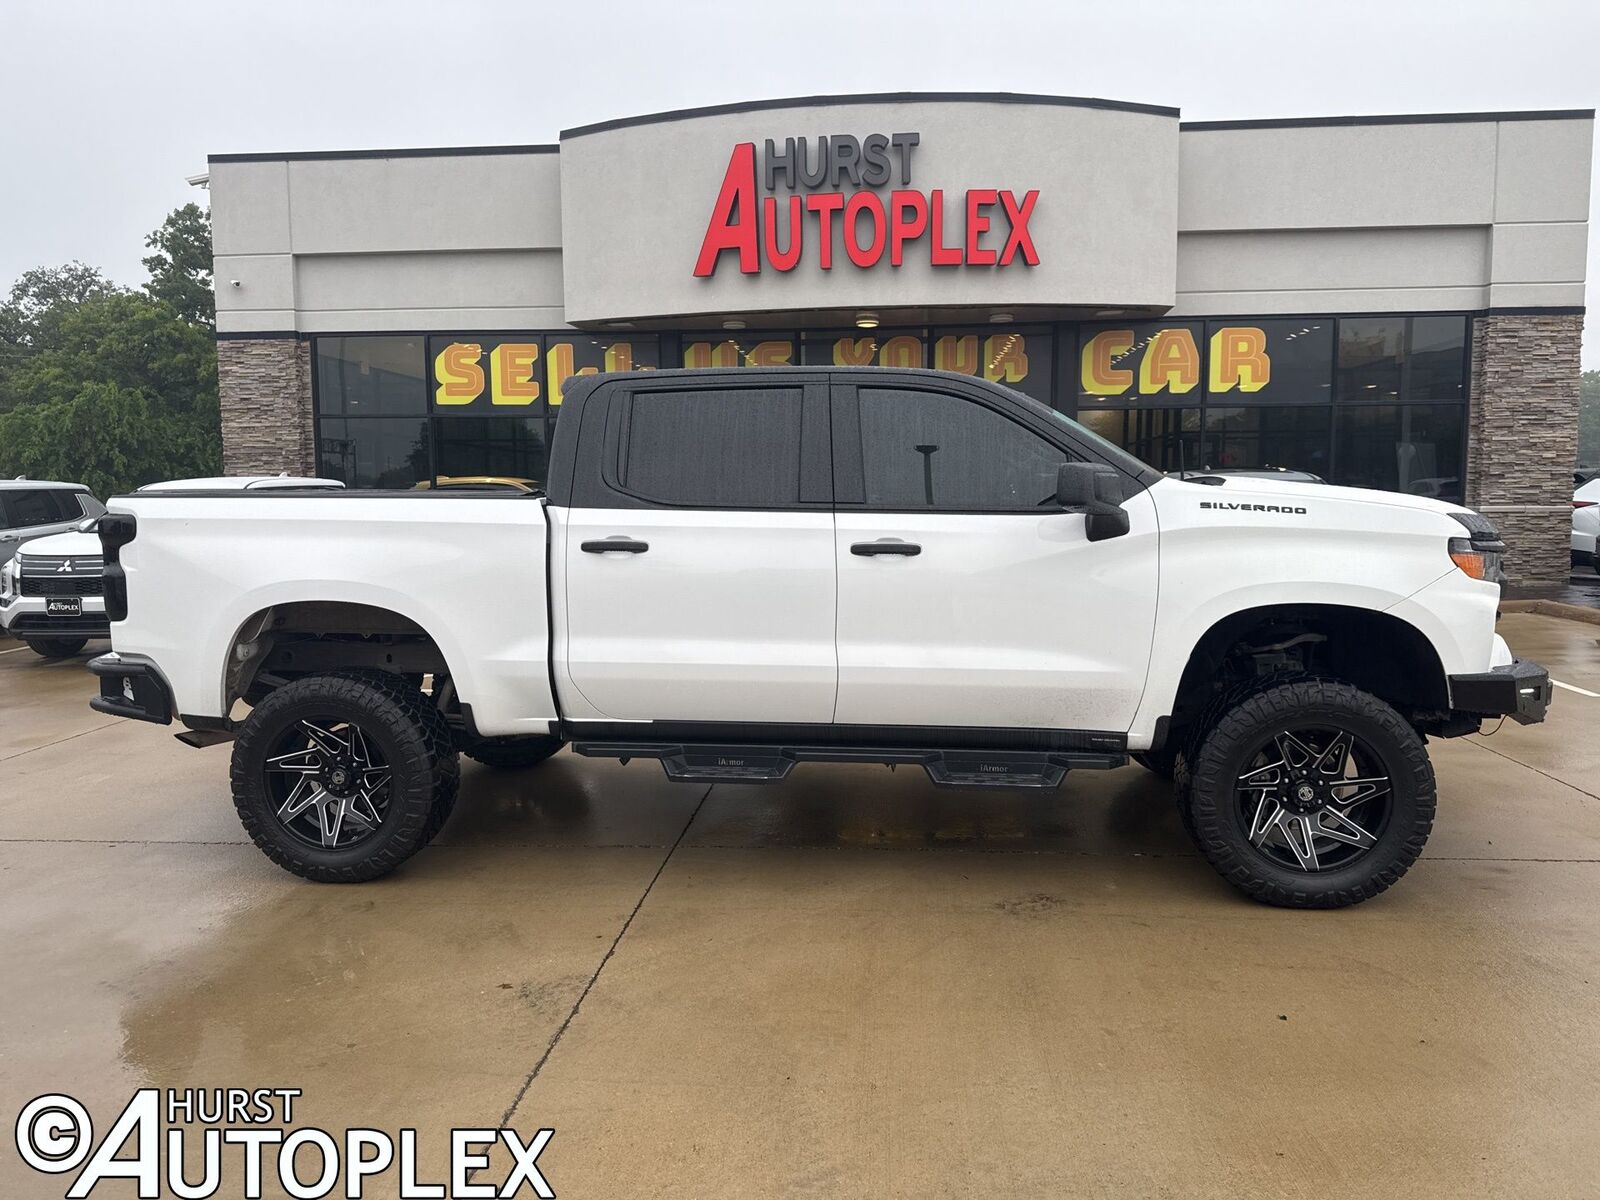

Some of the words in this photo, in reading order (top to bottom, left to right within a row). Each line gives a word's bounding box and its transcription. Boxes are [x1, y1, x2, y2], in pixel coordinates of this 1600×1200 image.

[765, 132, 920, 190] HURST
[693, 142, 1041, 277] AUTOPLEX
[1081, 327, 1270, 395] CAR
[1199, 502, 1307, 514] SILVERADO
[48, 602, 79, 611] AUTOPLEX
